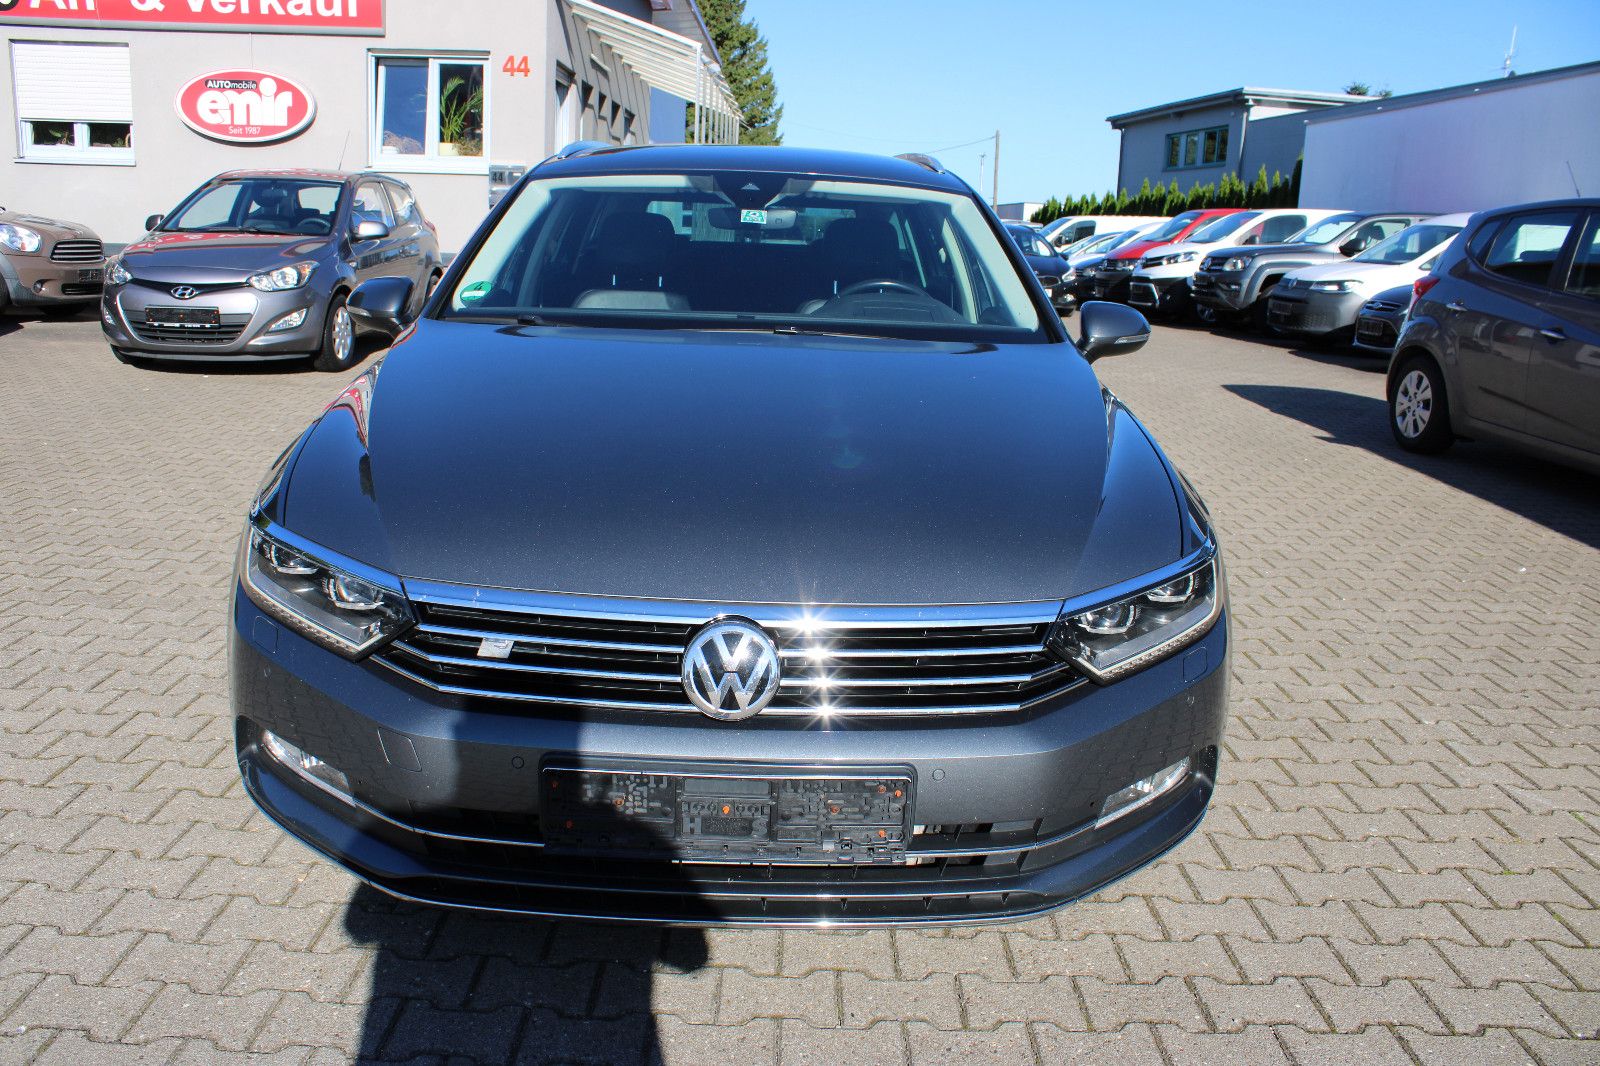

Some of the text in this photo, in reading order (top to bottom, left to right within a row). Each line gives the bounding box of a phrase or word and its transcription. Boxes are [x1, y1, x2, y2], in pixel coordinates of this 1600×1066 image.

[502, 55, 530, 77] 44
[206, 80, 257, 90] AUTOmobile
[196, 77, 293, 127] emir
[228, 126, 261, 135] Seit 1987
[492, 170, 504, 182] 44
[687, 621, 776, 715] VW
